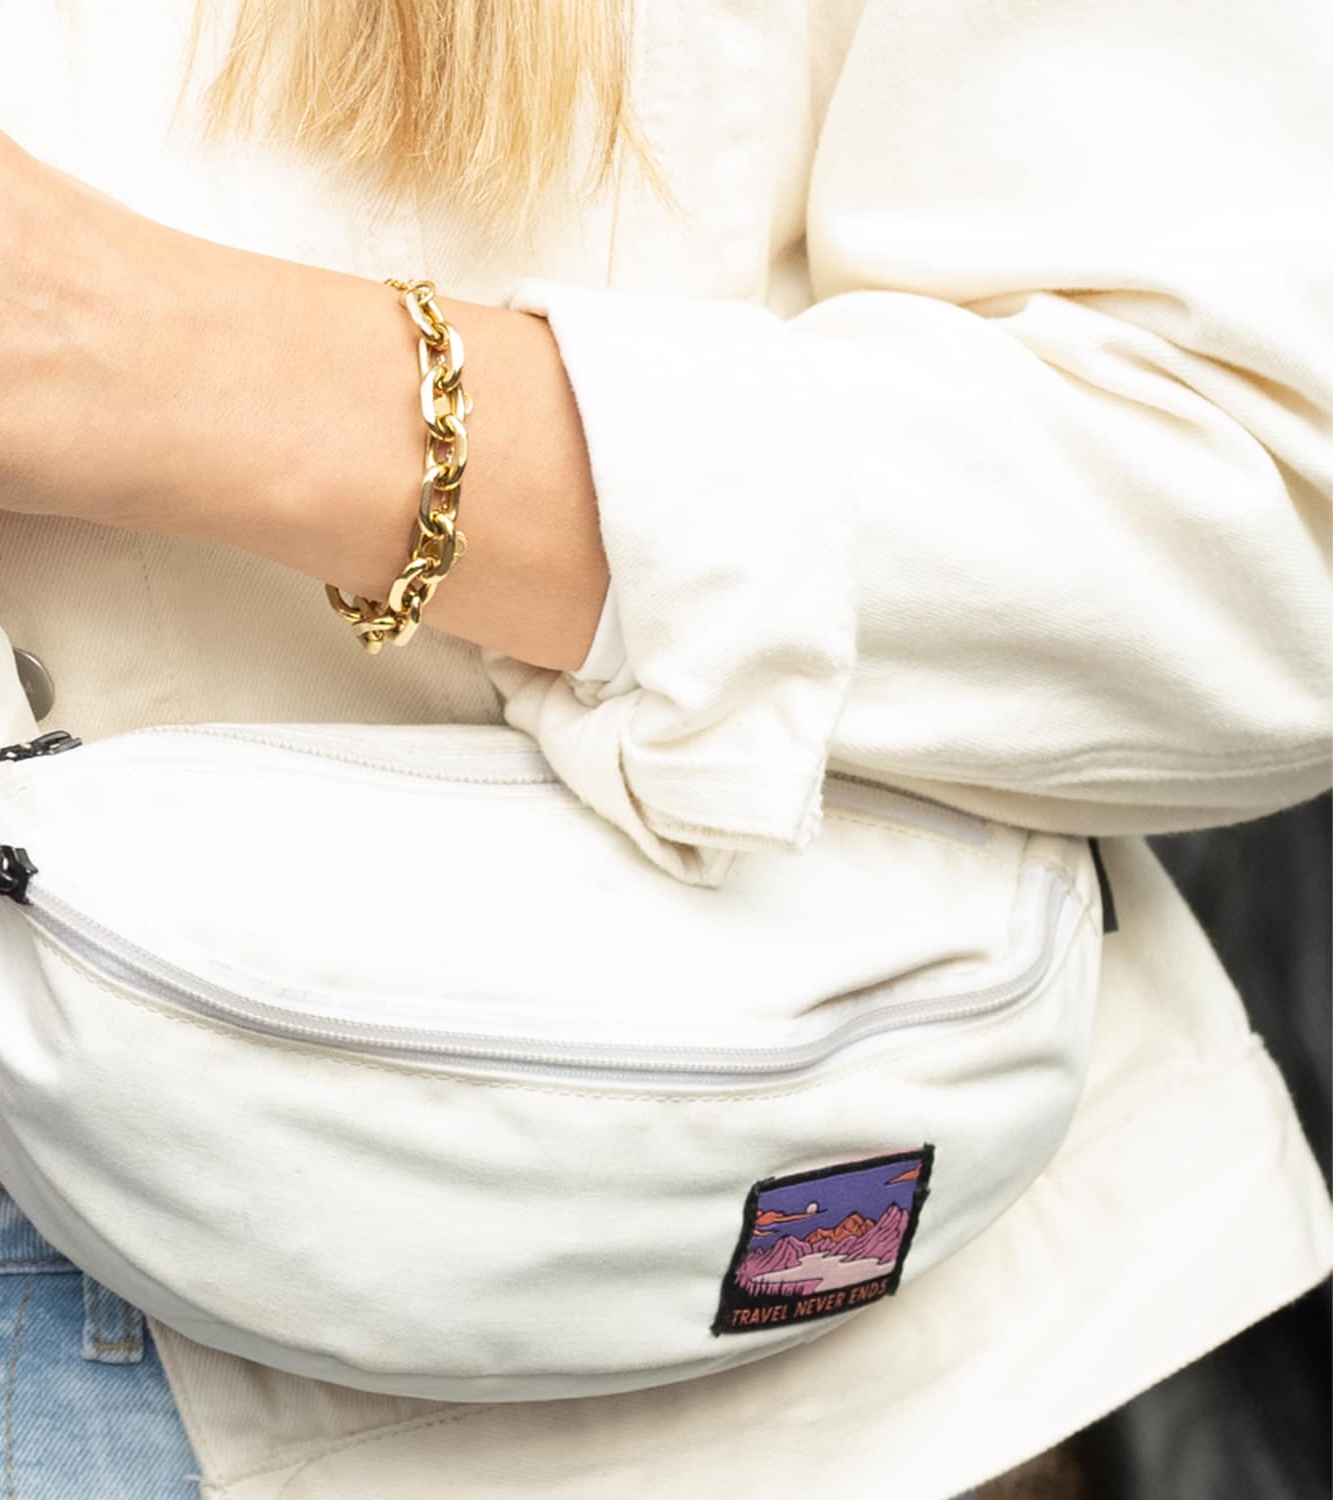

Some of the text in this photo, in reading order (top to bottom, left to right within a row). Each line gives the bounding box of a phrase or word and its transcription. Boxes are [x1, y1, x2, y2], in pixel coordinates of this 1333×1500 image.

[733, 1279, 888, 1326] TRAVEL NEVER ENDS
